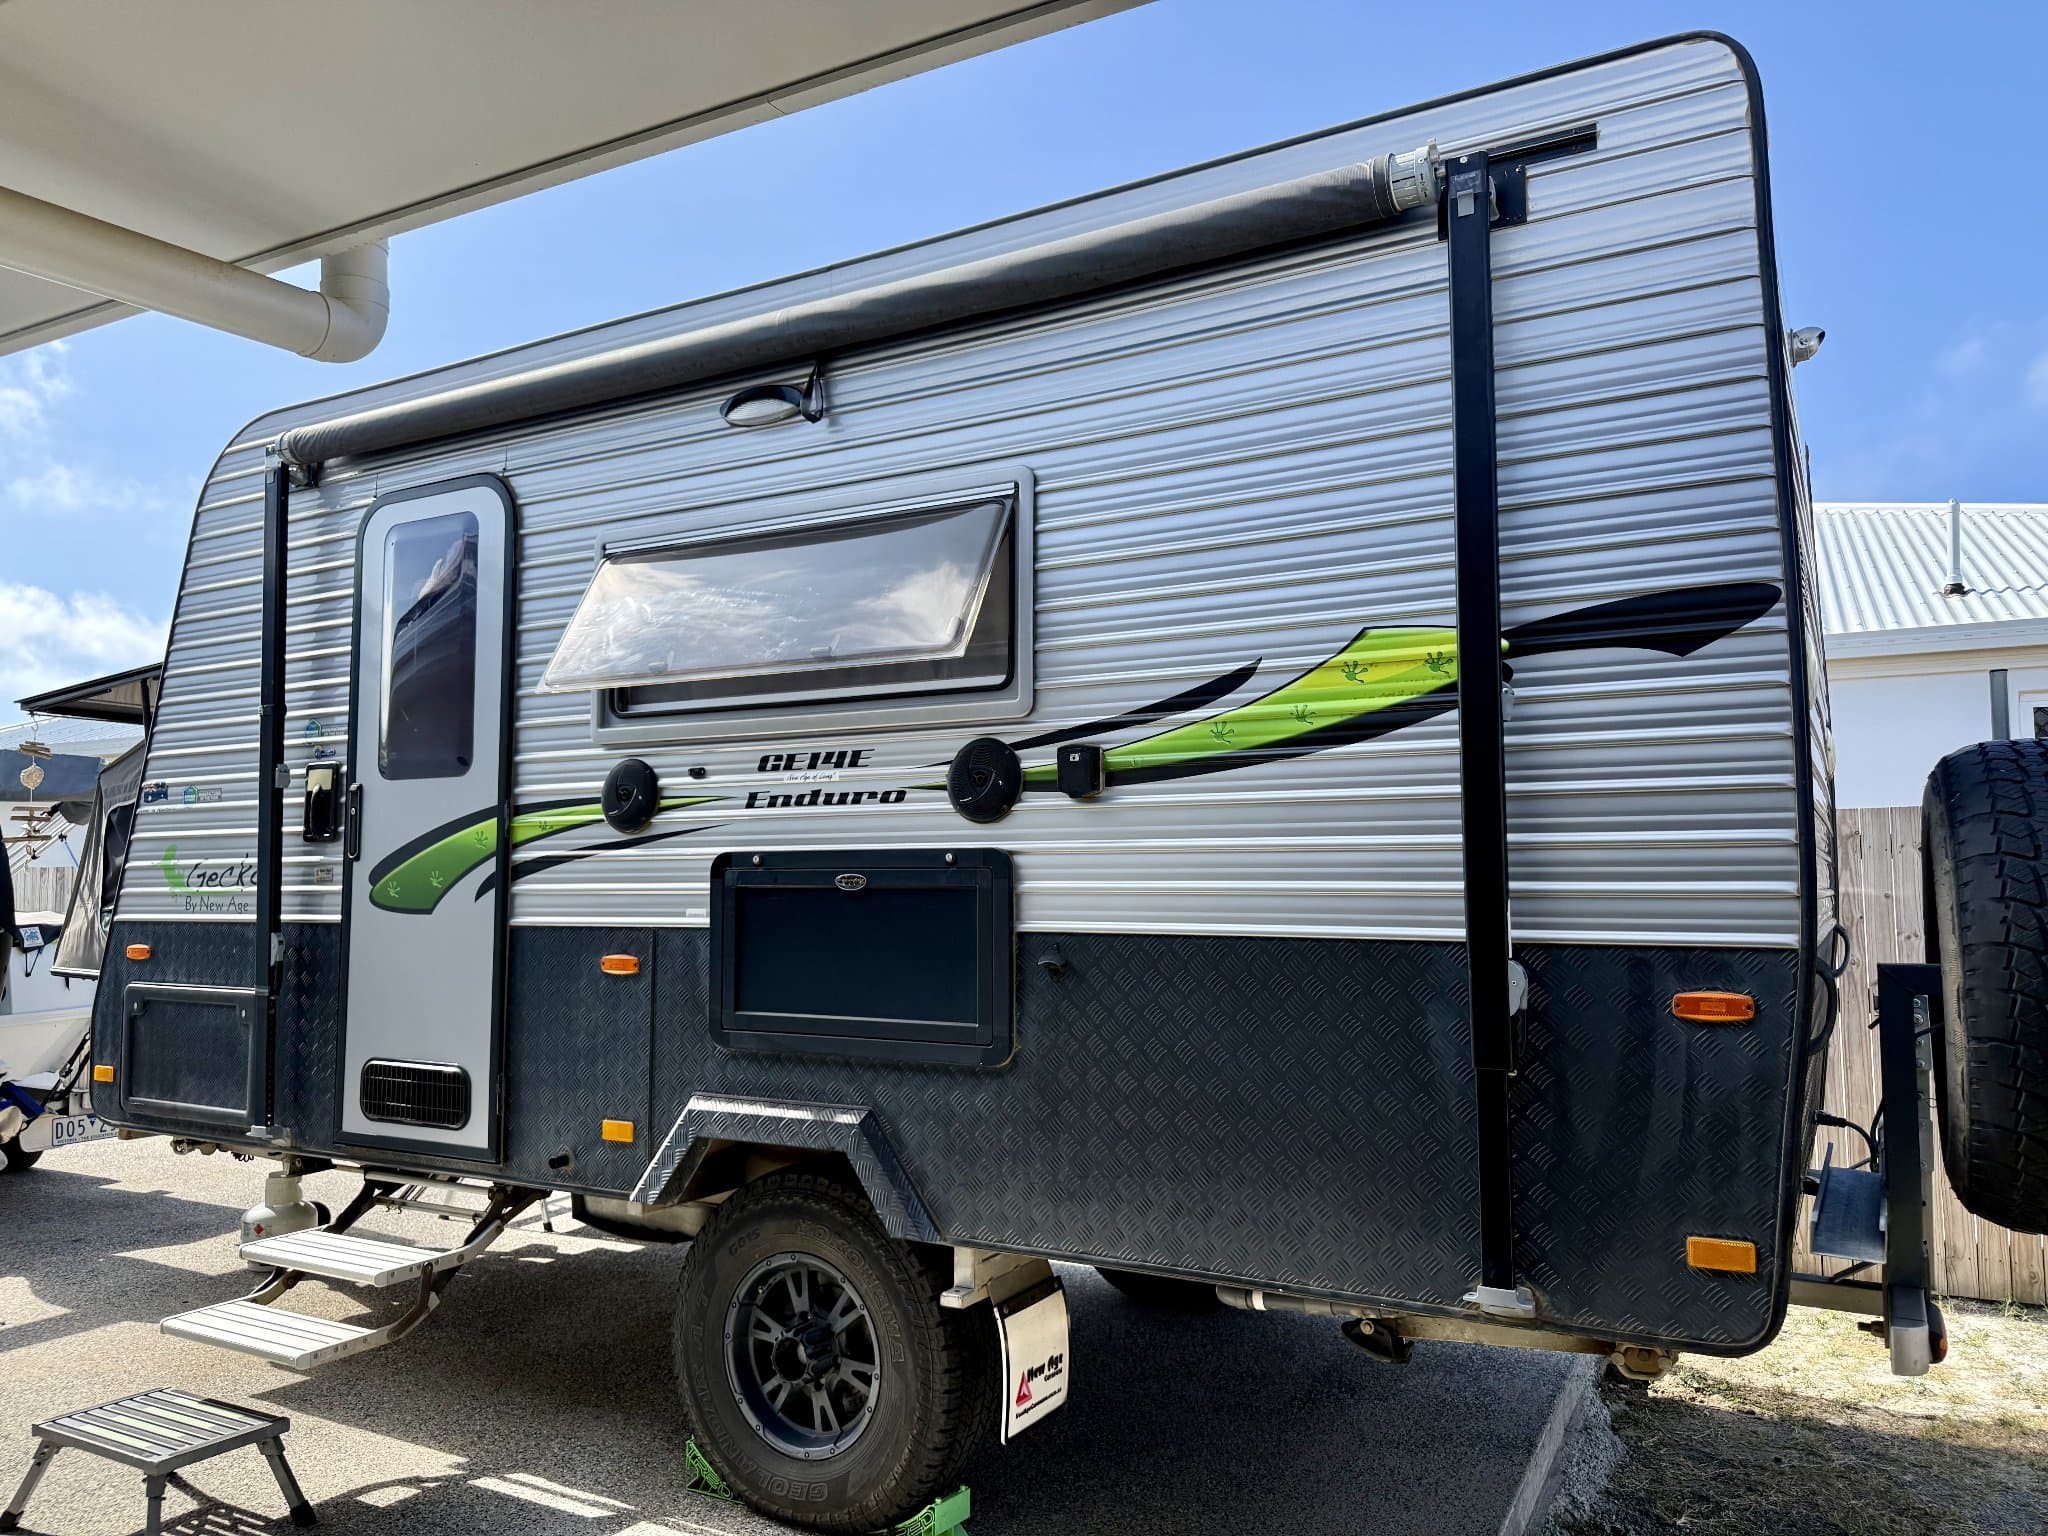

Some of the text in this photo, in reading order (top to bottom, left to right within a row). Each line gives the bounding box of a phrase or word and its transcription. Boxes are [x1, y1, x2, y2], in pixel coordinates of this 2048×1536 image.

[757, 748, 875, 772] GE14E
[744, 788, 907, 809] Enduro
[185, 895, 249, 913] By New Age
[796, 1218, 905, 1363] YOKOHAMA
[1027, 1362, 1046, 1383] New
